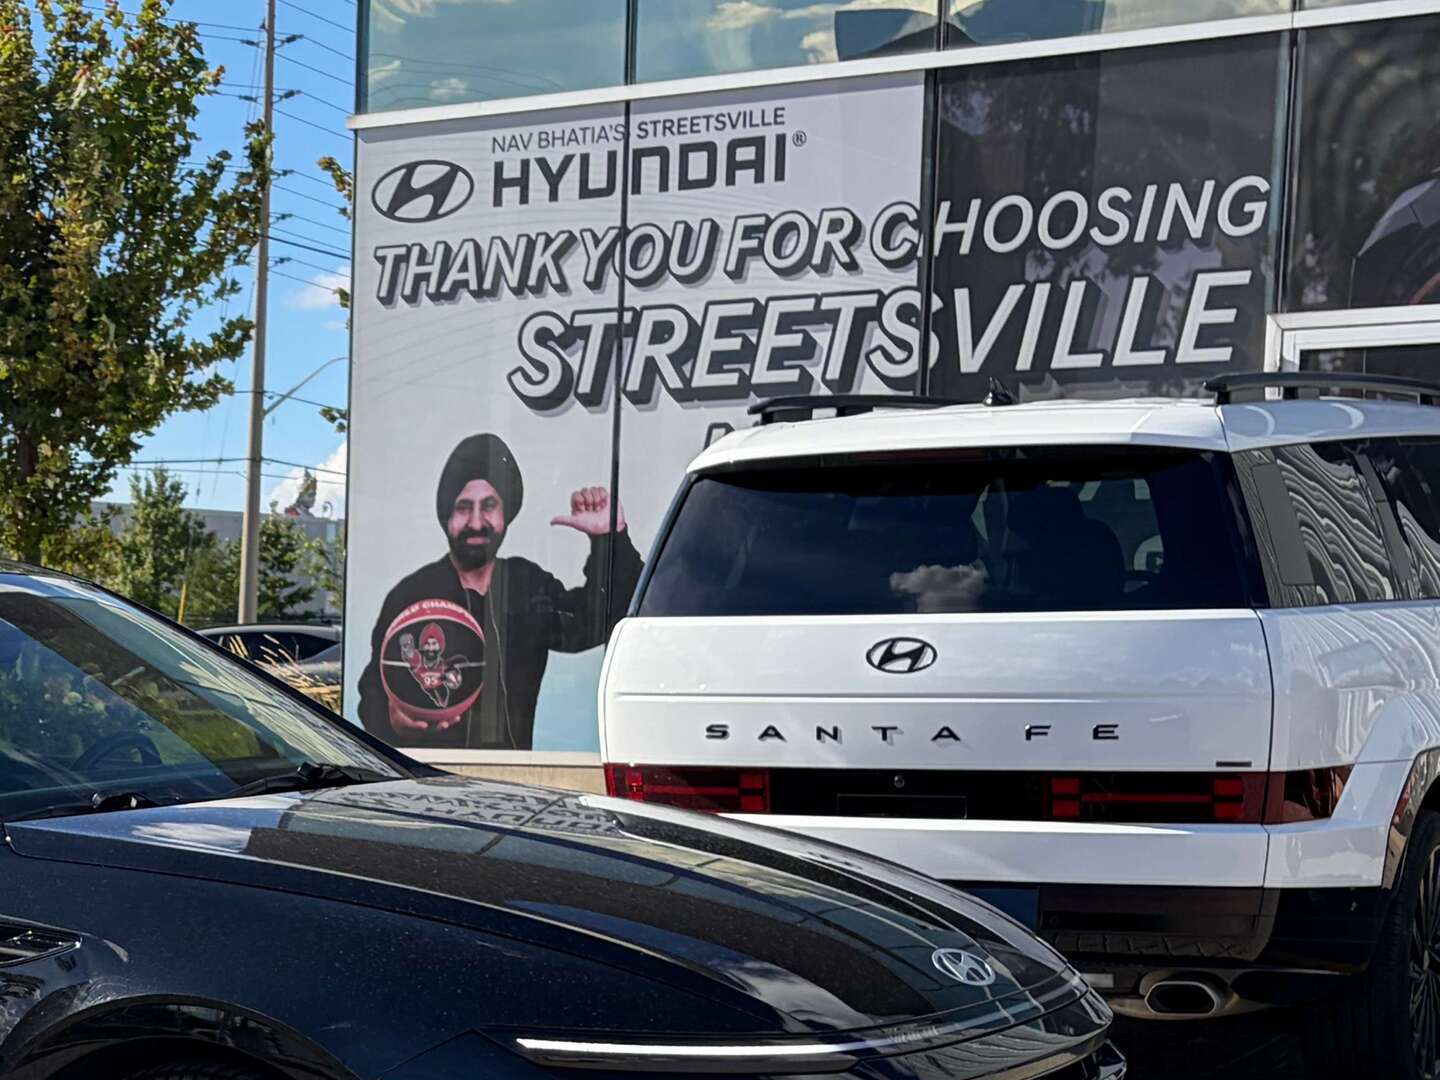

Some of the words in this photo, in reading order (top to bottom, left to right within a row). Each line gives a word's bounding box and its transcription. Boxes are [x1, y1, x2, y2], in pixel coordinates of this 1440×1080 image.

[492, 132, 534, 154] NAV
[538, 123, 626, 149] BHATIA'S
[636, 106, 787, 140] STREETSVILLE
[374, 229, 577, 304] THANK
[580, 217, 720, 291] YOU
[723, 205, 861, 280] FOR
[870, 174, 1271, 271] CHOOSING
[506, 268, 1253, 411] STREETSVILLE
[704, 723, 961, 742] SANTA
[1024, 723, 1120, 742] FE
